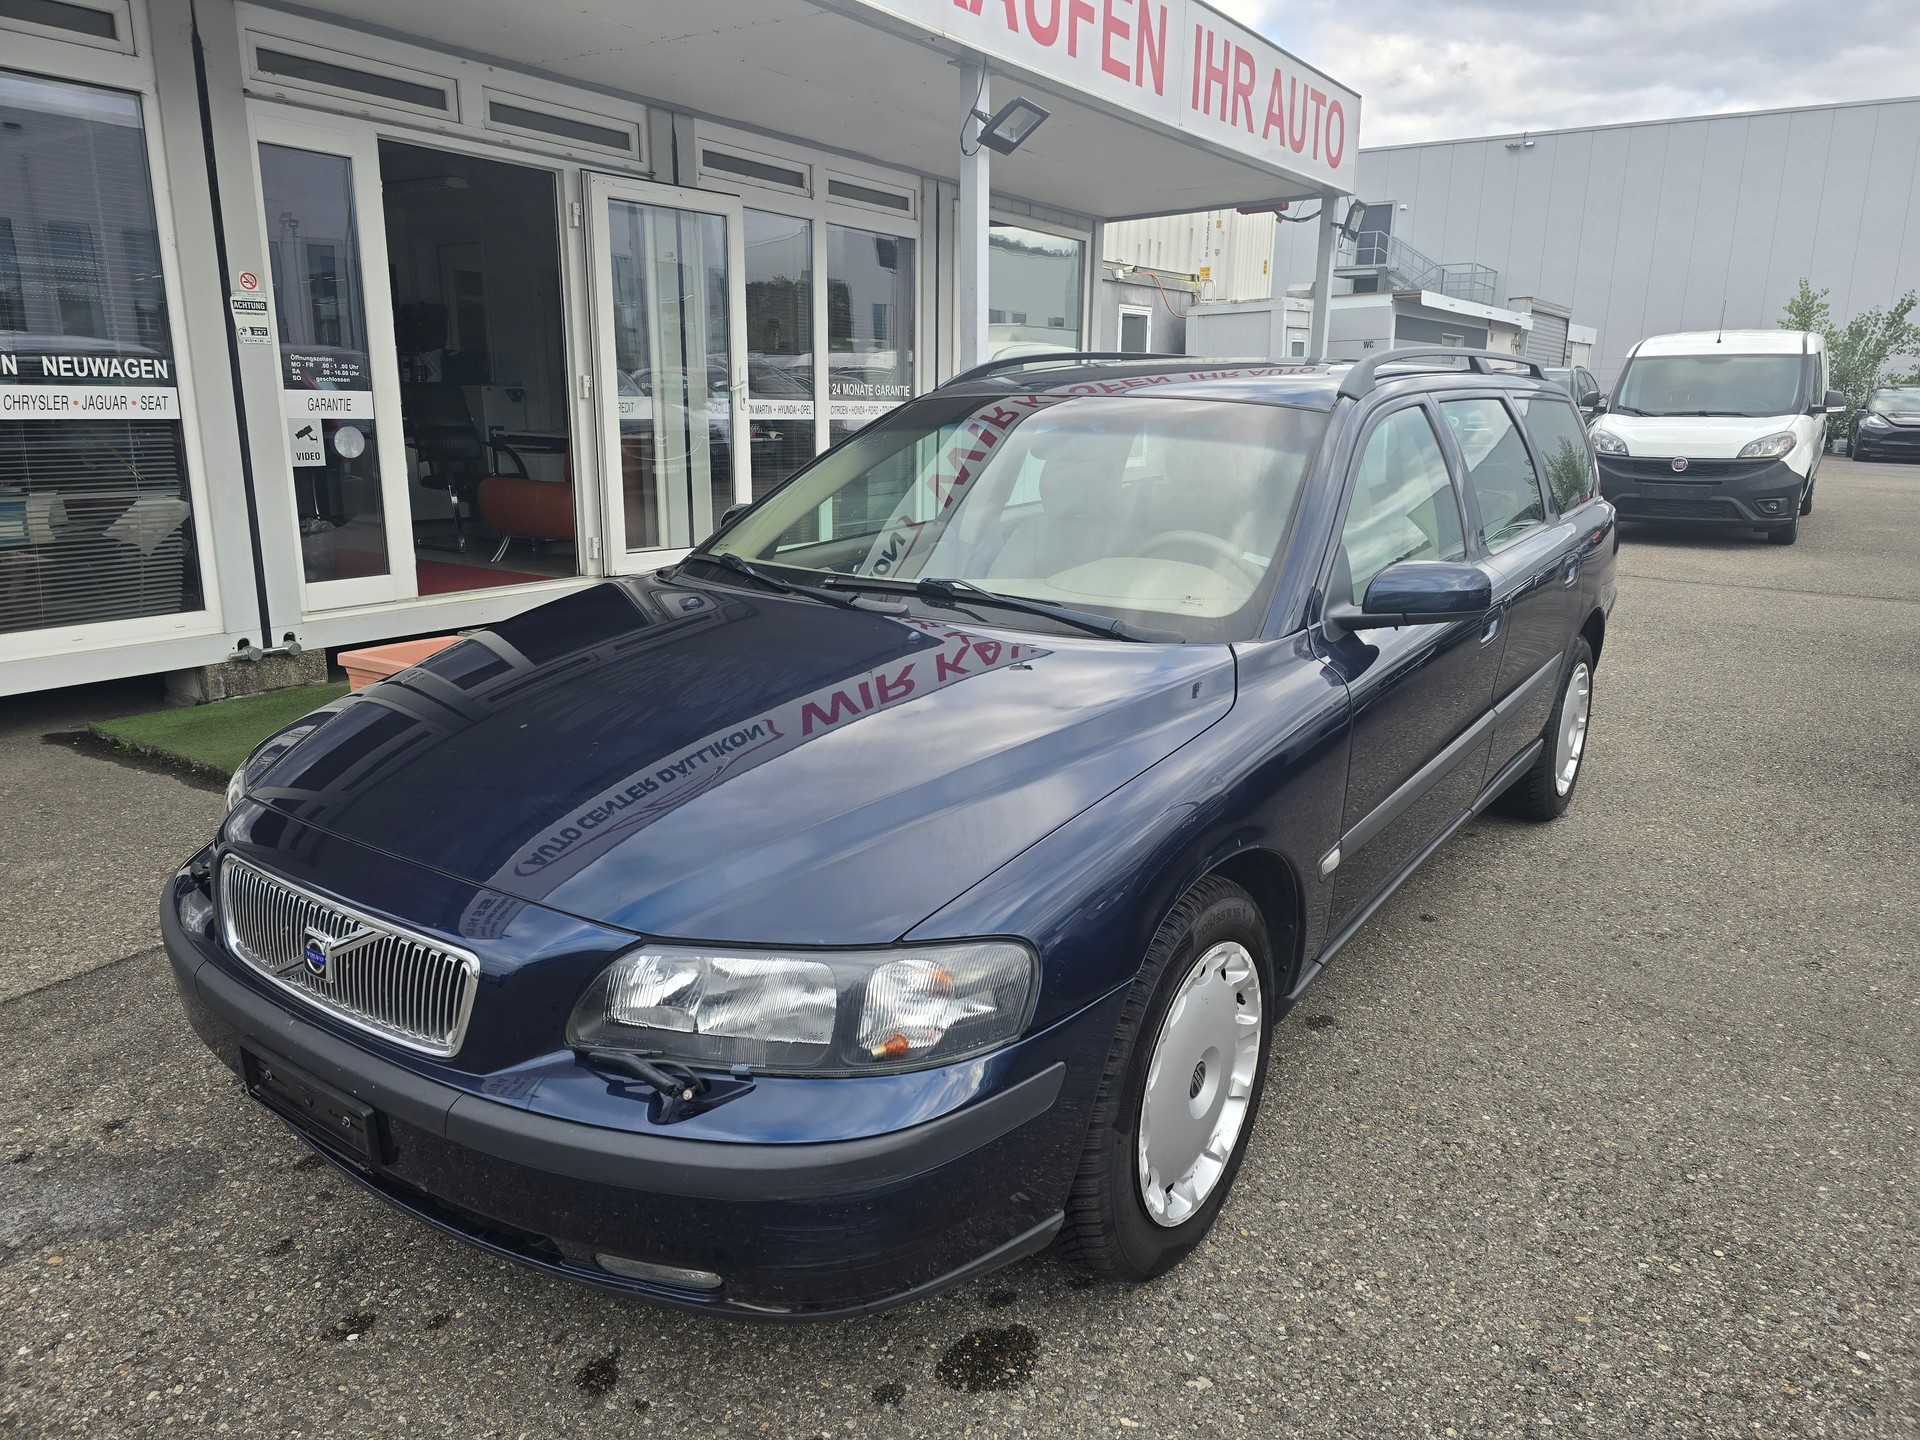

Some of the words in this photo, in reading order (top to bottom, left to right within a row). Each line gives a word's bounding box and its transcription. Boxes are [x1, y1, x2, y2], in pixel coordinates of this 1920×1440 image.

[953, 0, 1168, 97] UFEN
[1192, 24, 1255, 134] IHR
[1262, 68, 1345, 169] AUTO
[233, 301, 266, 310] ACHTUNG
[1363, 341, 1374, 349] WC
[41, 355, 169, 379] NEUWAGEN
[832, 383, 841, 395] 24
[842, 384, 873, 396] MONATE
[875, 385, 910, 397] GARANTIE
[3, 394, 69, 411] CHRYSLER
[82, 395, 128, 411] JAGUAR
[140, 395, 168, 411] SEAT
[307, 397, 352, 411] GARANTIE
[296, 452, 321, 461] VIDEO
[306, 950, 324, 962] VOLVO
